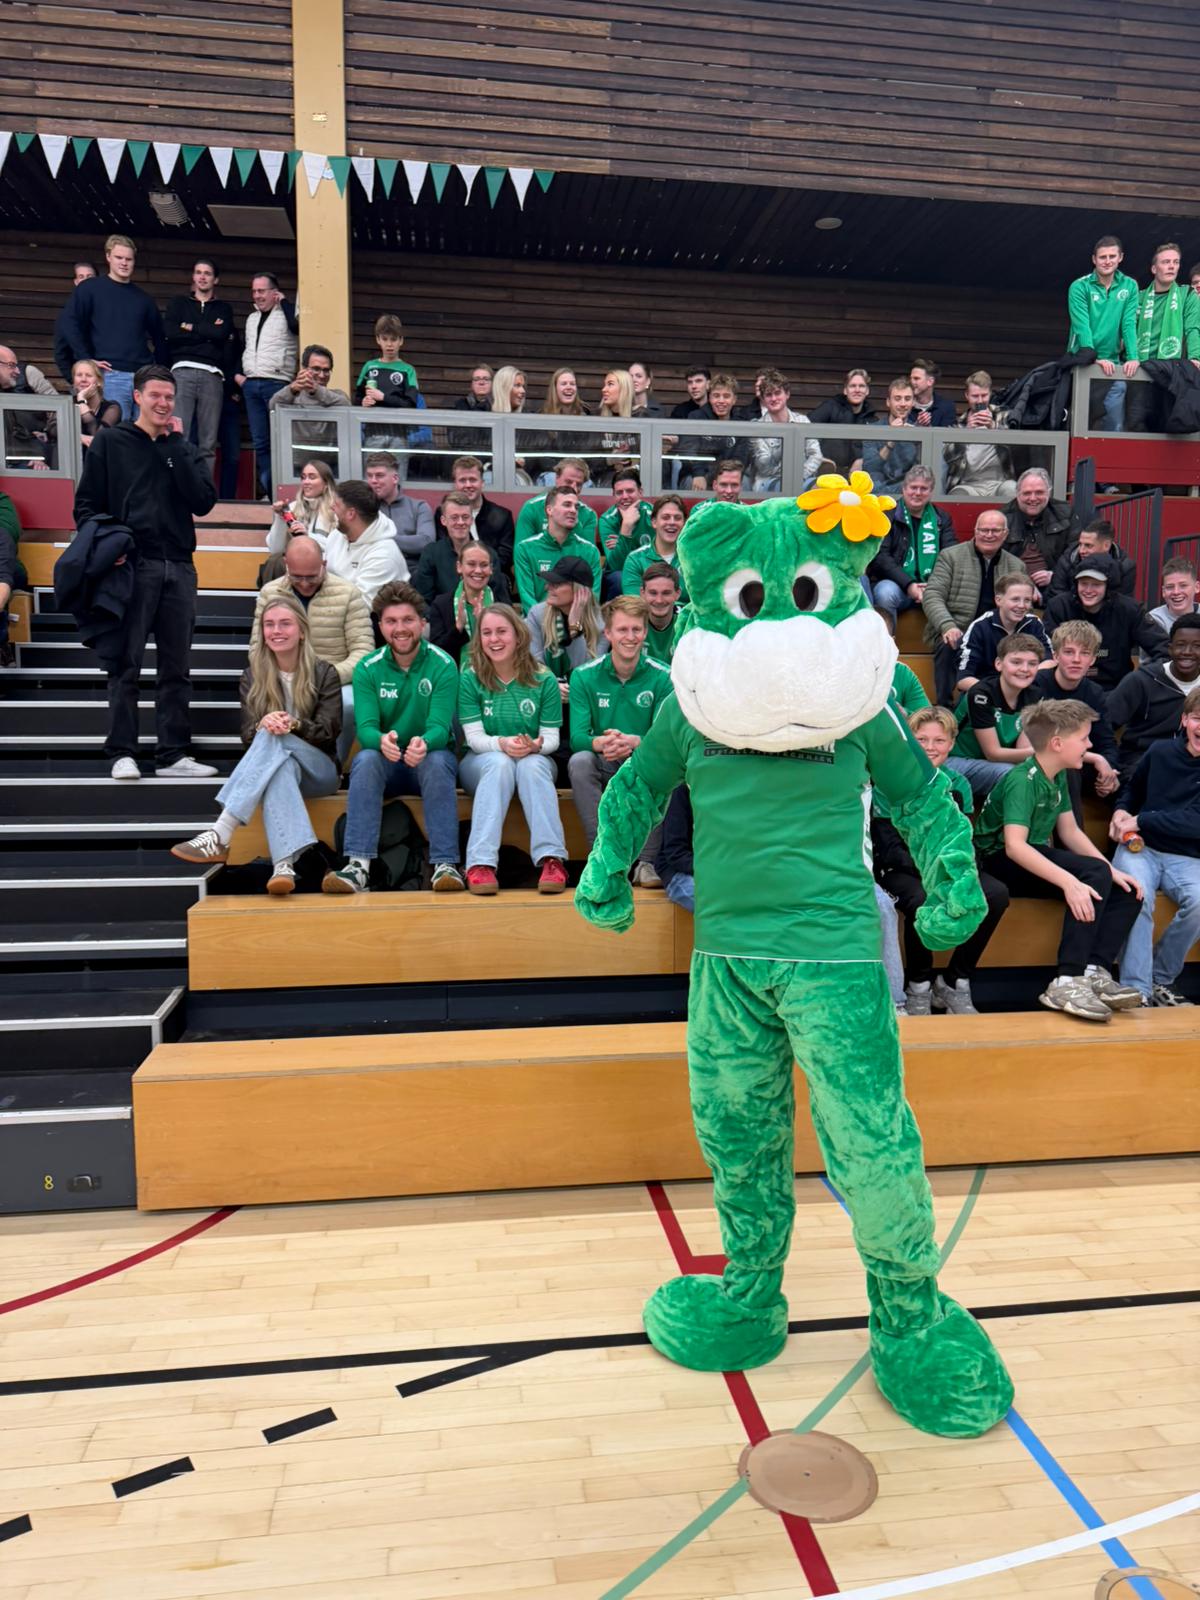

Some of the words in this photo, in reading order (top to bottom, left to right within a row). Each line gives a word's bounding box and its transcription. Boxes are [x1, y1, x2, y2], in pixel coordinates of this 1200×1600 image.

[922, 521, 937, 554] VAN
[380, 687, 399, 699] DvK
[44, 1175, 54, 1190] 8
